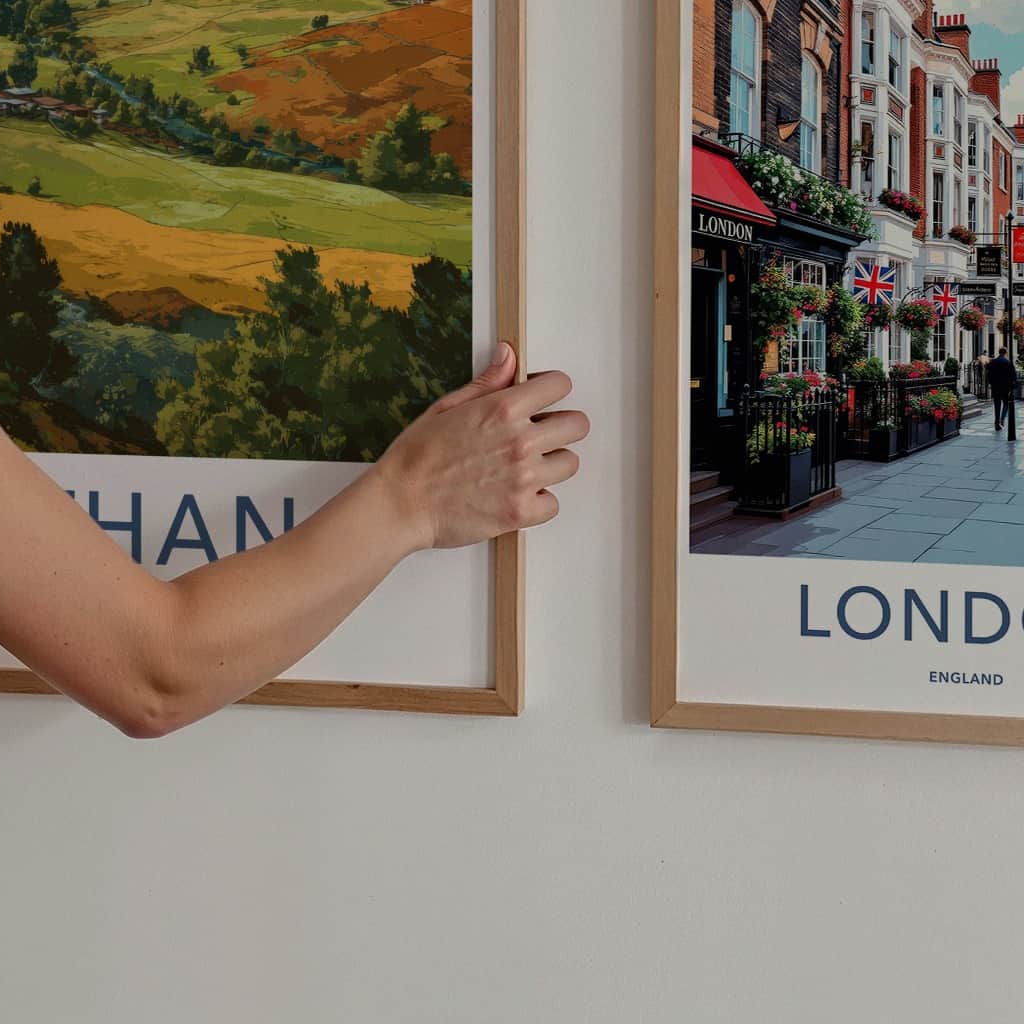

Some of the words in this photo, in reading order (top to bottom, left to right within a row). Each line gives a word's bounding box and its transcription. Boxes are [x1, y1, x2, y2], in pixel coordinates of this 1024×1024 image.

[698, 213, 753, 242] LONDON
[800, 584, 1024, 645] LOND
[929, 671, 1005, 686] ENGLAND
